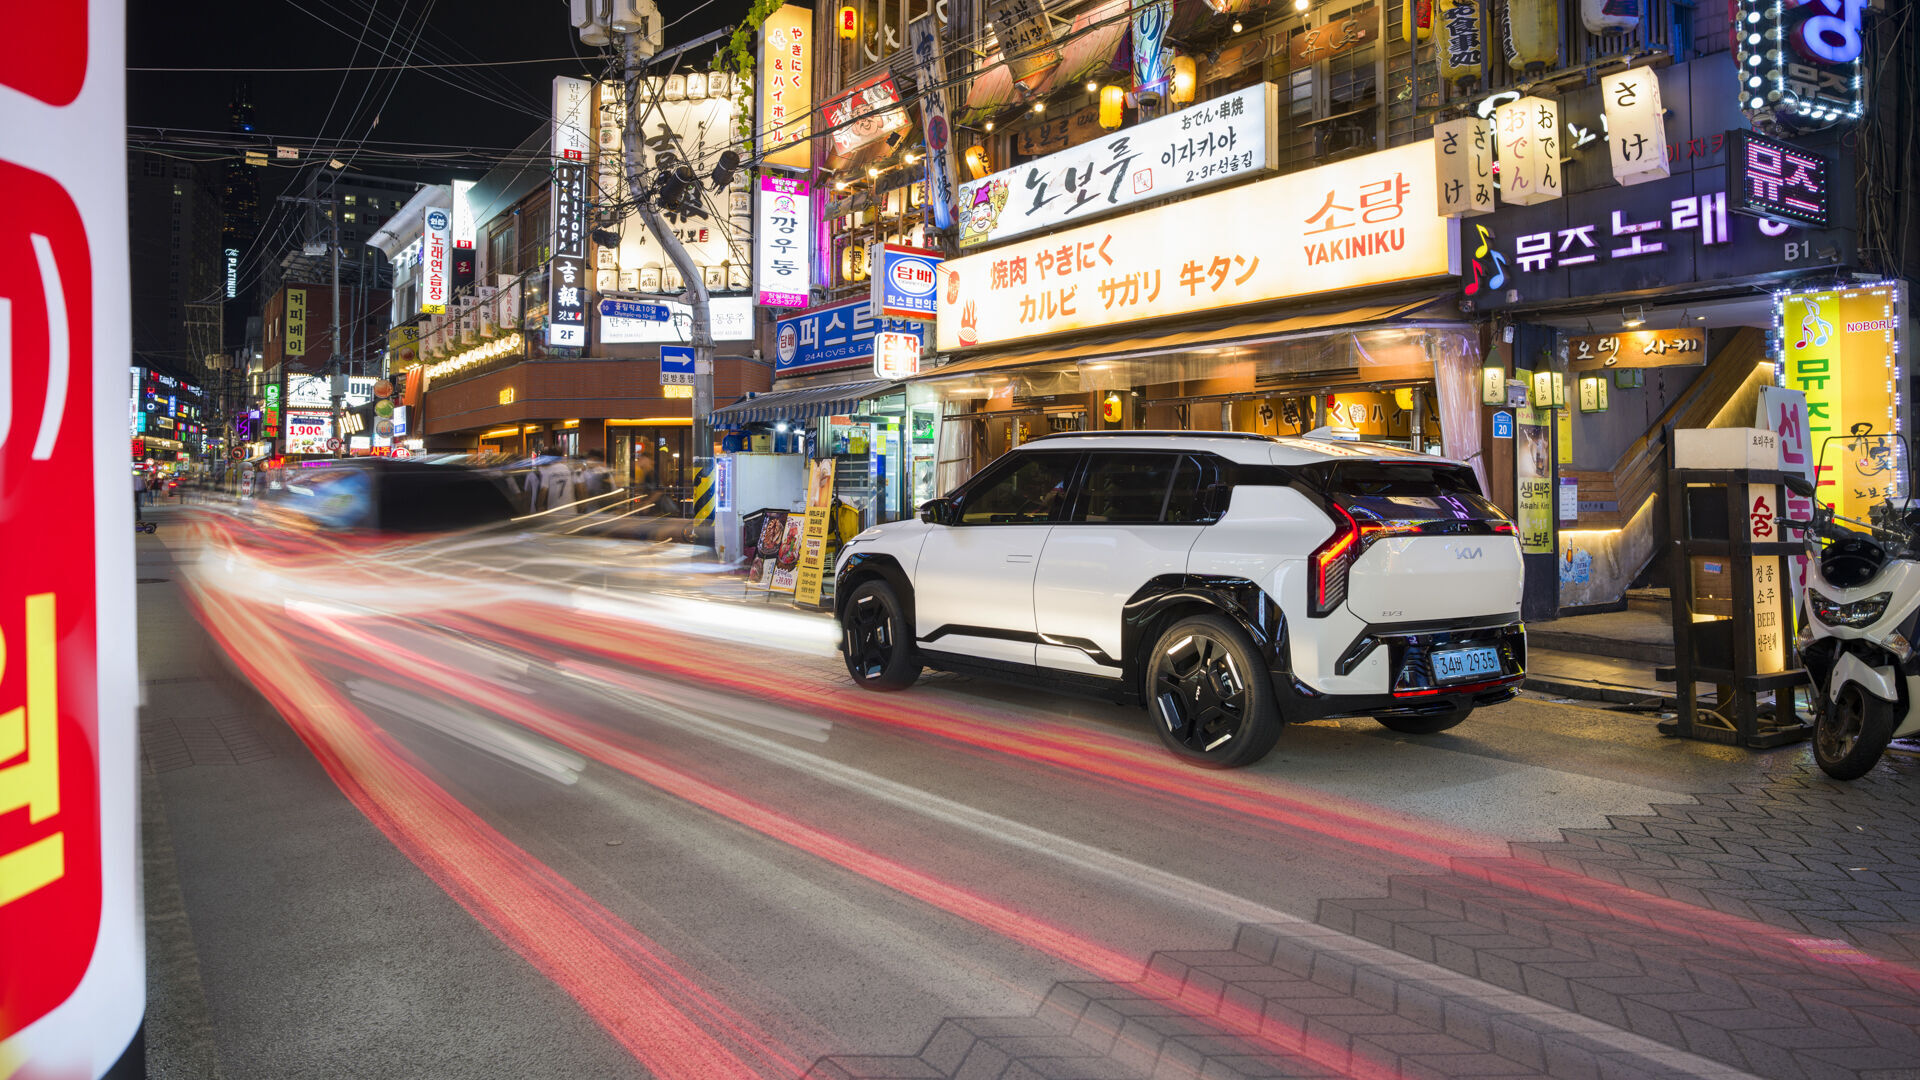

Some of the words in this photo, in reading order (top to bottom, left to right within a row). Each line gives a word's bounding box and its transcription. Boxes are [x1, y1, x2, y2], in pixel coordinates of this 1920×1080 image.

[791, 28, 803, 87] やきにく
[1615, 82, 1648, 162] さけ
[1160, 125, 1238, 168] 이자카야
[1442, 131, 1465, 204] さけ
[1473, 125, 1492, 206] さしみ
[1503, 109, 1530, 192] おでん
[1537, 104, 1559, 189] おでん
[1025, 136, 1146, 216] 노보루
[1747, 142, 1819, 212] 뮤즈
[1304, 172, 1410, 235] 소량
[429, 232, 444, 301] 노래연습장
[770, 217, 799, 275] 깡우동
[990, 255, 1028, 290] 焼肉
[1035, 234, 1114, 281] やきにく
[1304, 227, 1405, 267] YAKINIKU
[1516, 224, 1596, 272] 뮤즈
[1783, 240, 1816, 262] B1
[226, 257, 237, 298] PLATINUM
[897, 266, 932, 285] 담배
[1019, 286, 1077, 325] カルビ
[1097, 268, 1162, 311] サガリ
[1180, 254, 1260, 298] 牛タン
[289, 293, 303, 352] 커피베이
[428, 305, 441, 314] 3F
[766, 298, 803, 306] 423-3777
[560, 330, 575, 340] 2F
[780, 333, 795, 349] 담배
[799, 305, 876, 351] 퍼스트
[1847, 319, 1894, 336] NOBORU
[805, 350, 823, 362] 24시
[825, 347, 846, 359] CVS
[1577, 337, 1620, 367] 오뎅
[1643, 338, 1698, 355] 사케
[1498, 424, 1508, 436] 20
[1520, 481, 1551, 500] 생맥주
[1750, 495, 1774, 538] 술
[1522, 531, 1551, 548] 노보루
[1756, 588, 1776, 605] 소주
[1757, 611, 1776, 628] BEER
[1466, 651, 1495, 672] 2935
